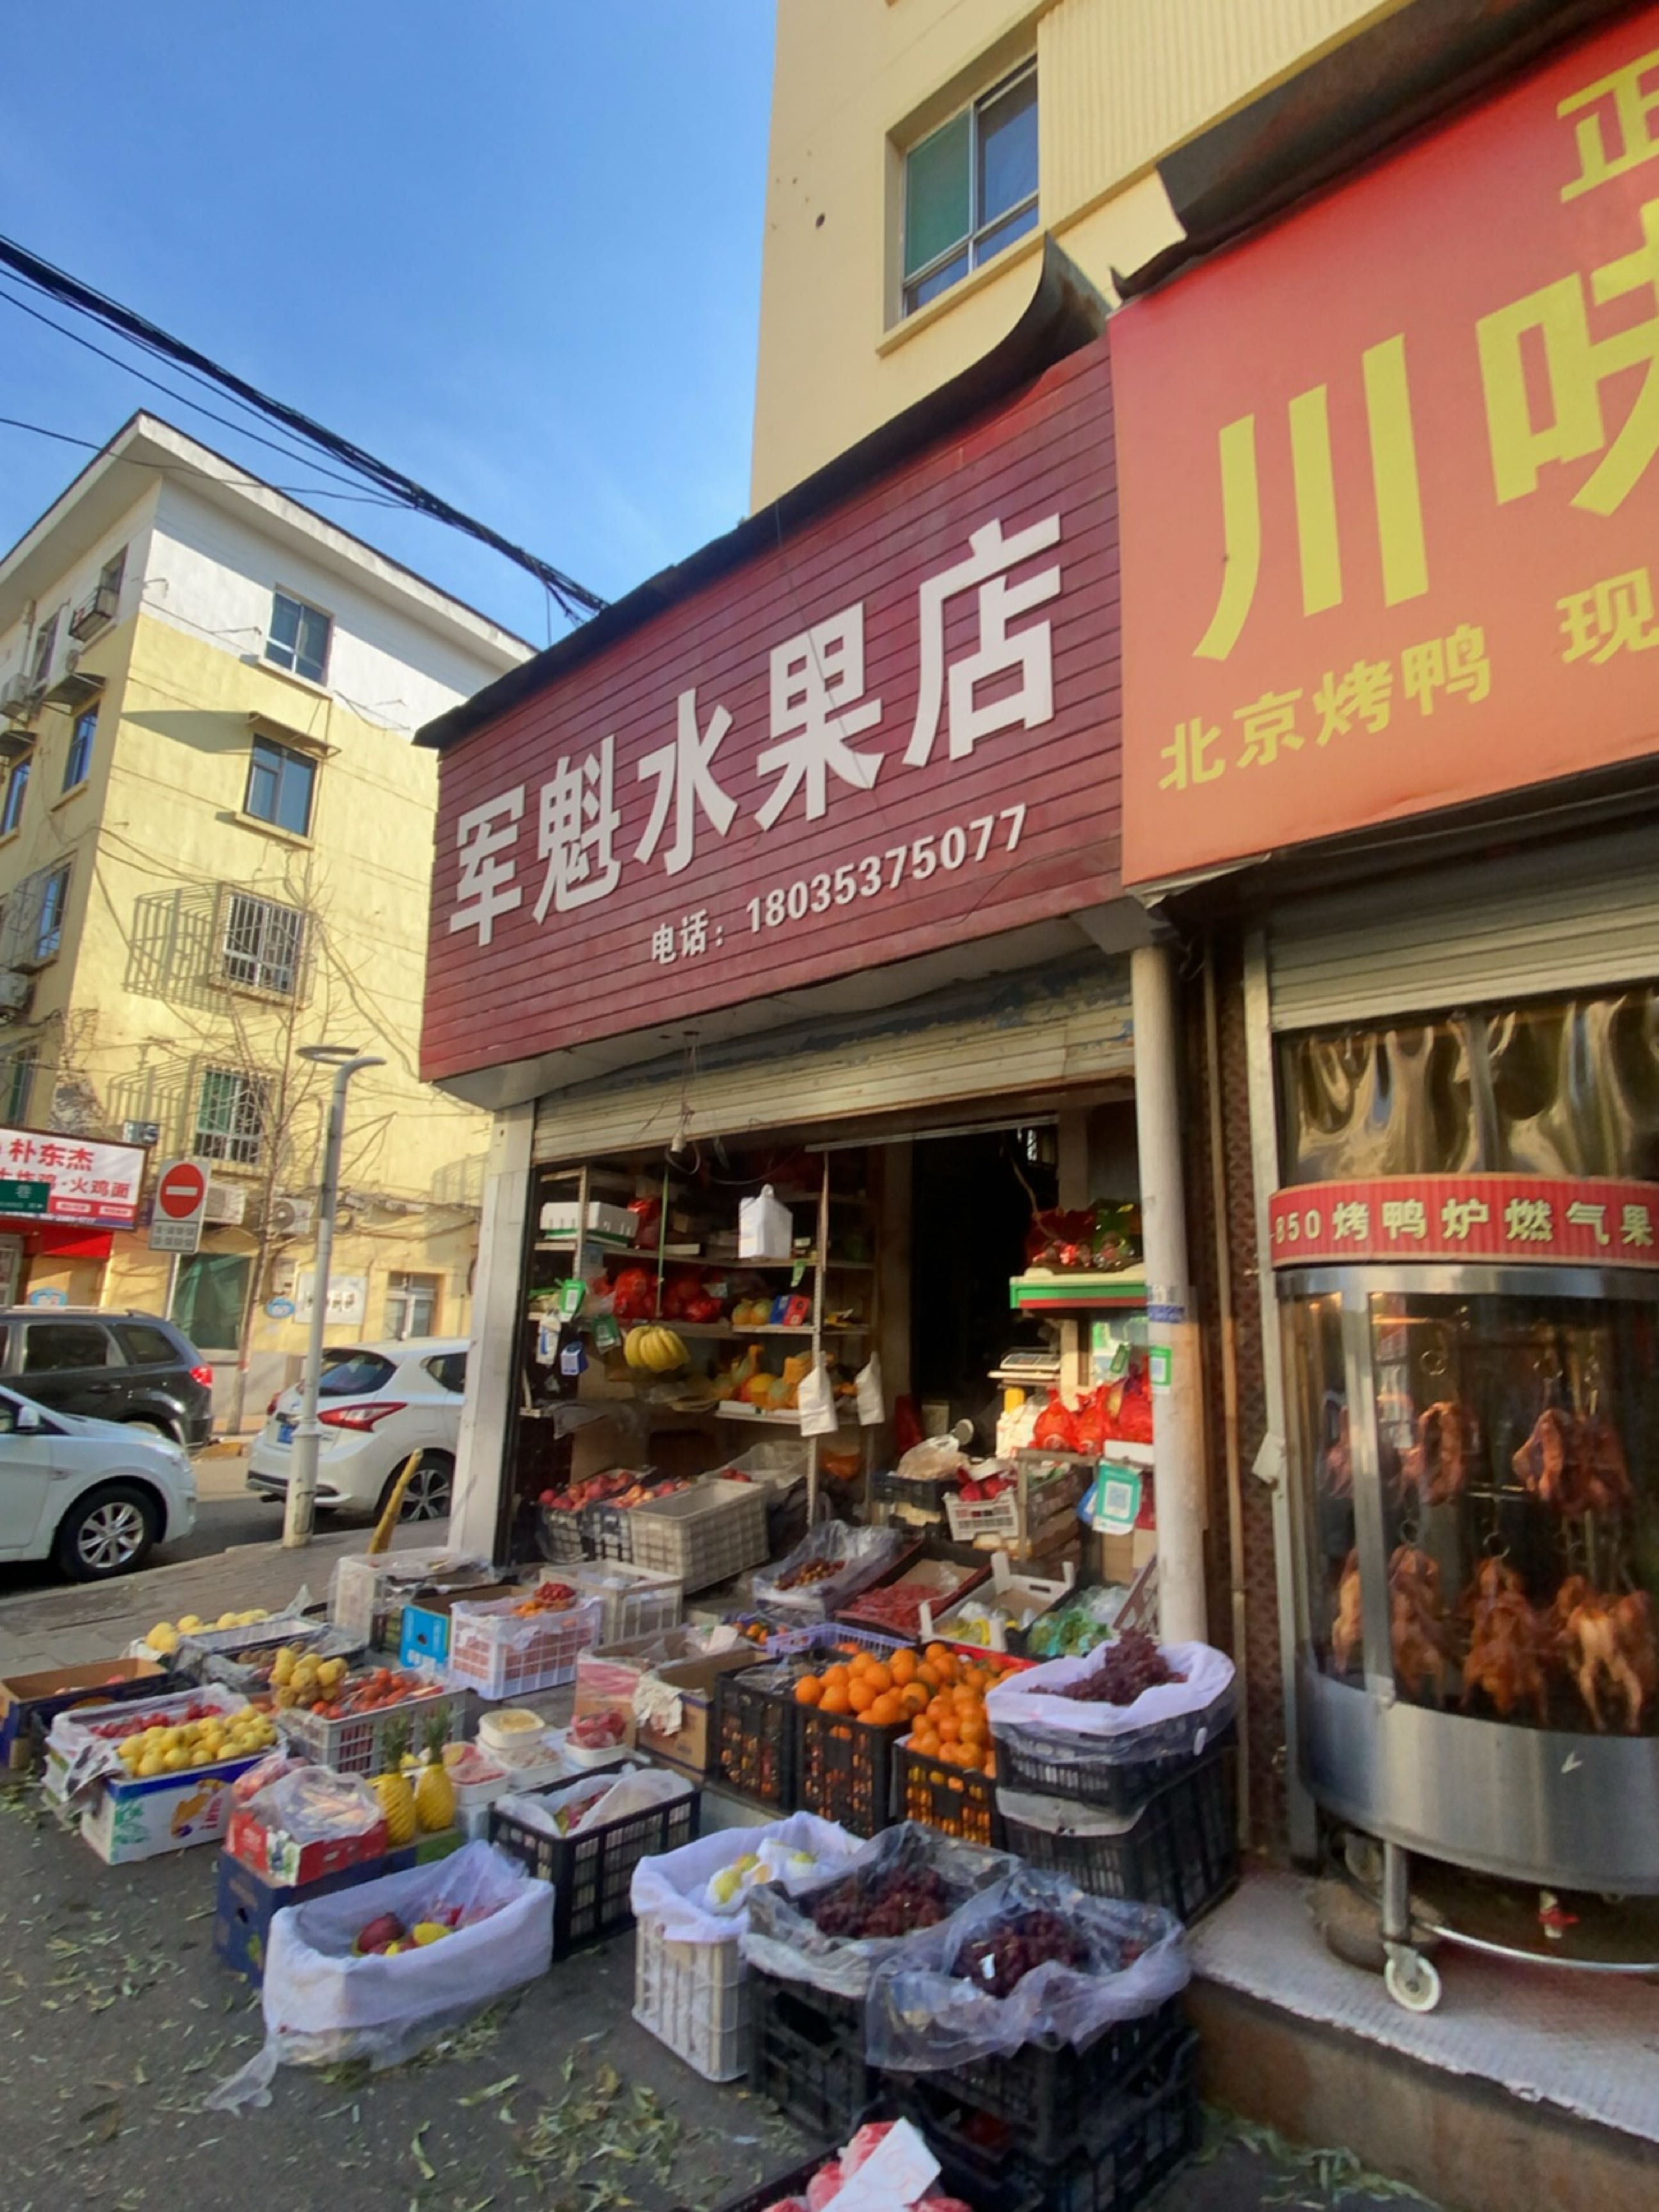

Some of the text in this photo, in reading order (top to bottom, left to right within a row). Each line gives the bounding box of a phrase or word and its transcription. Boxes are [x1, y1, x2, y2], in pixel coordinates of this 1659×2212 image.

[450, 512, 1061, 947] 军魁水果店
[1158, 623, 1491, 791] 北京烤鸭
